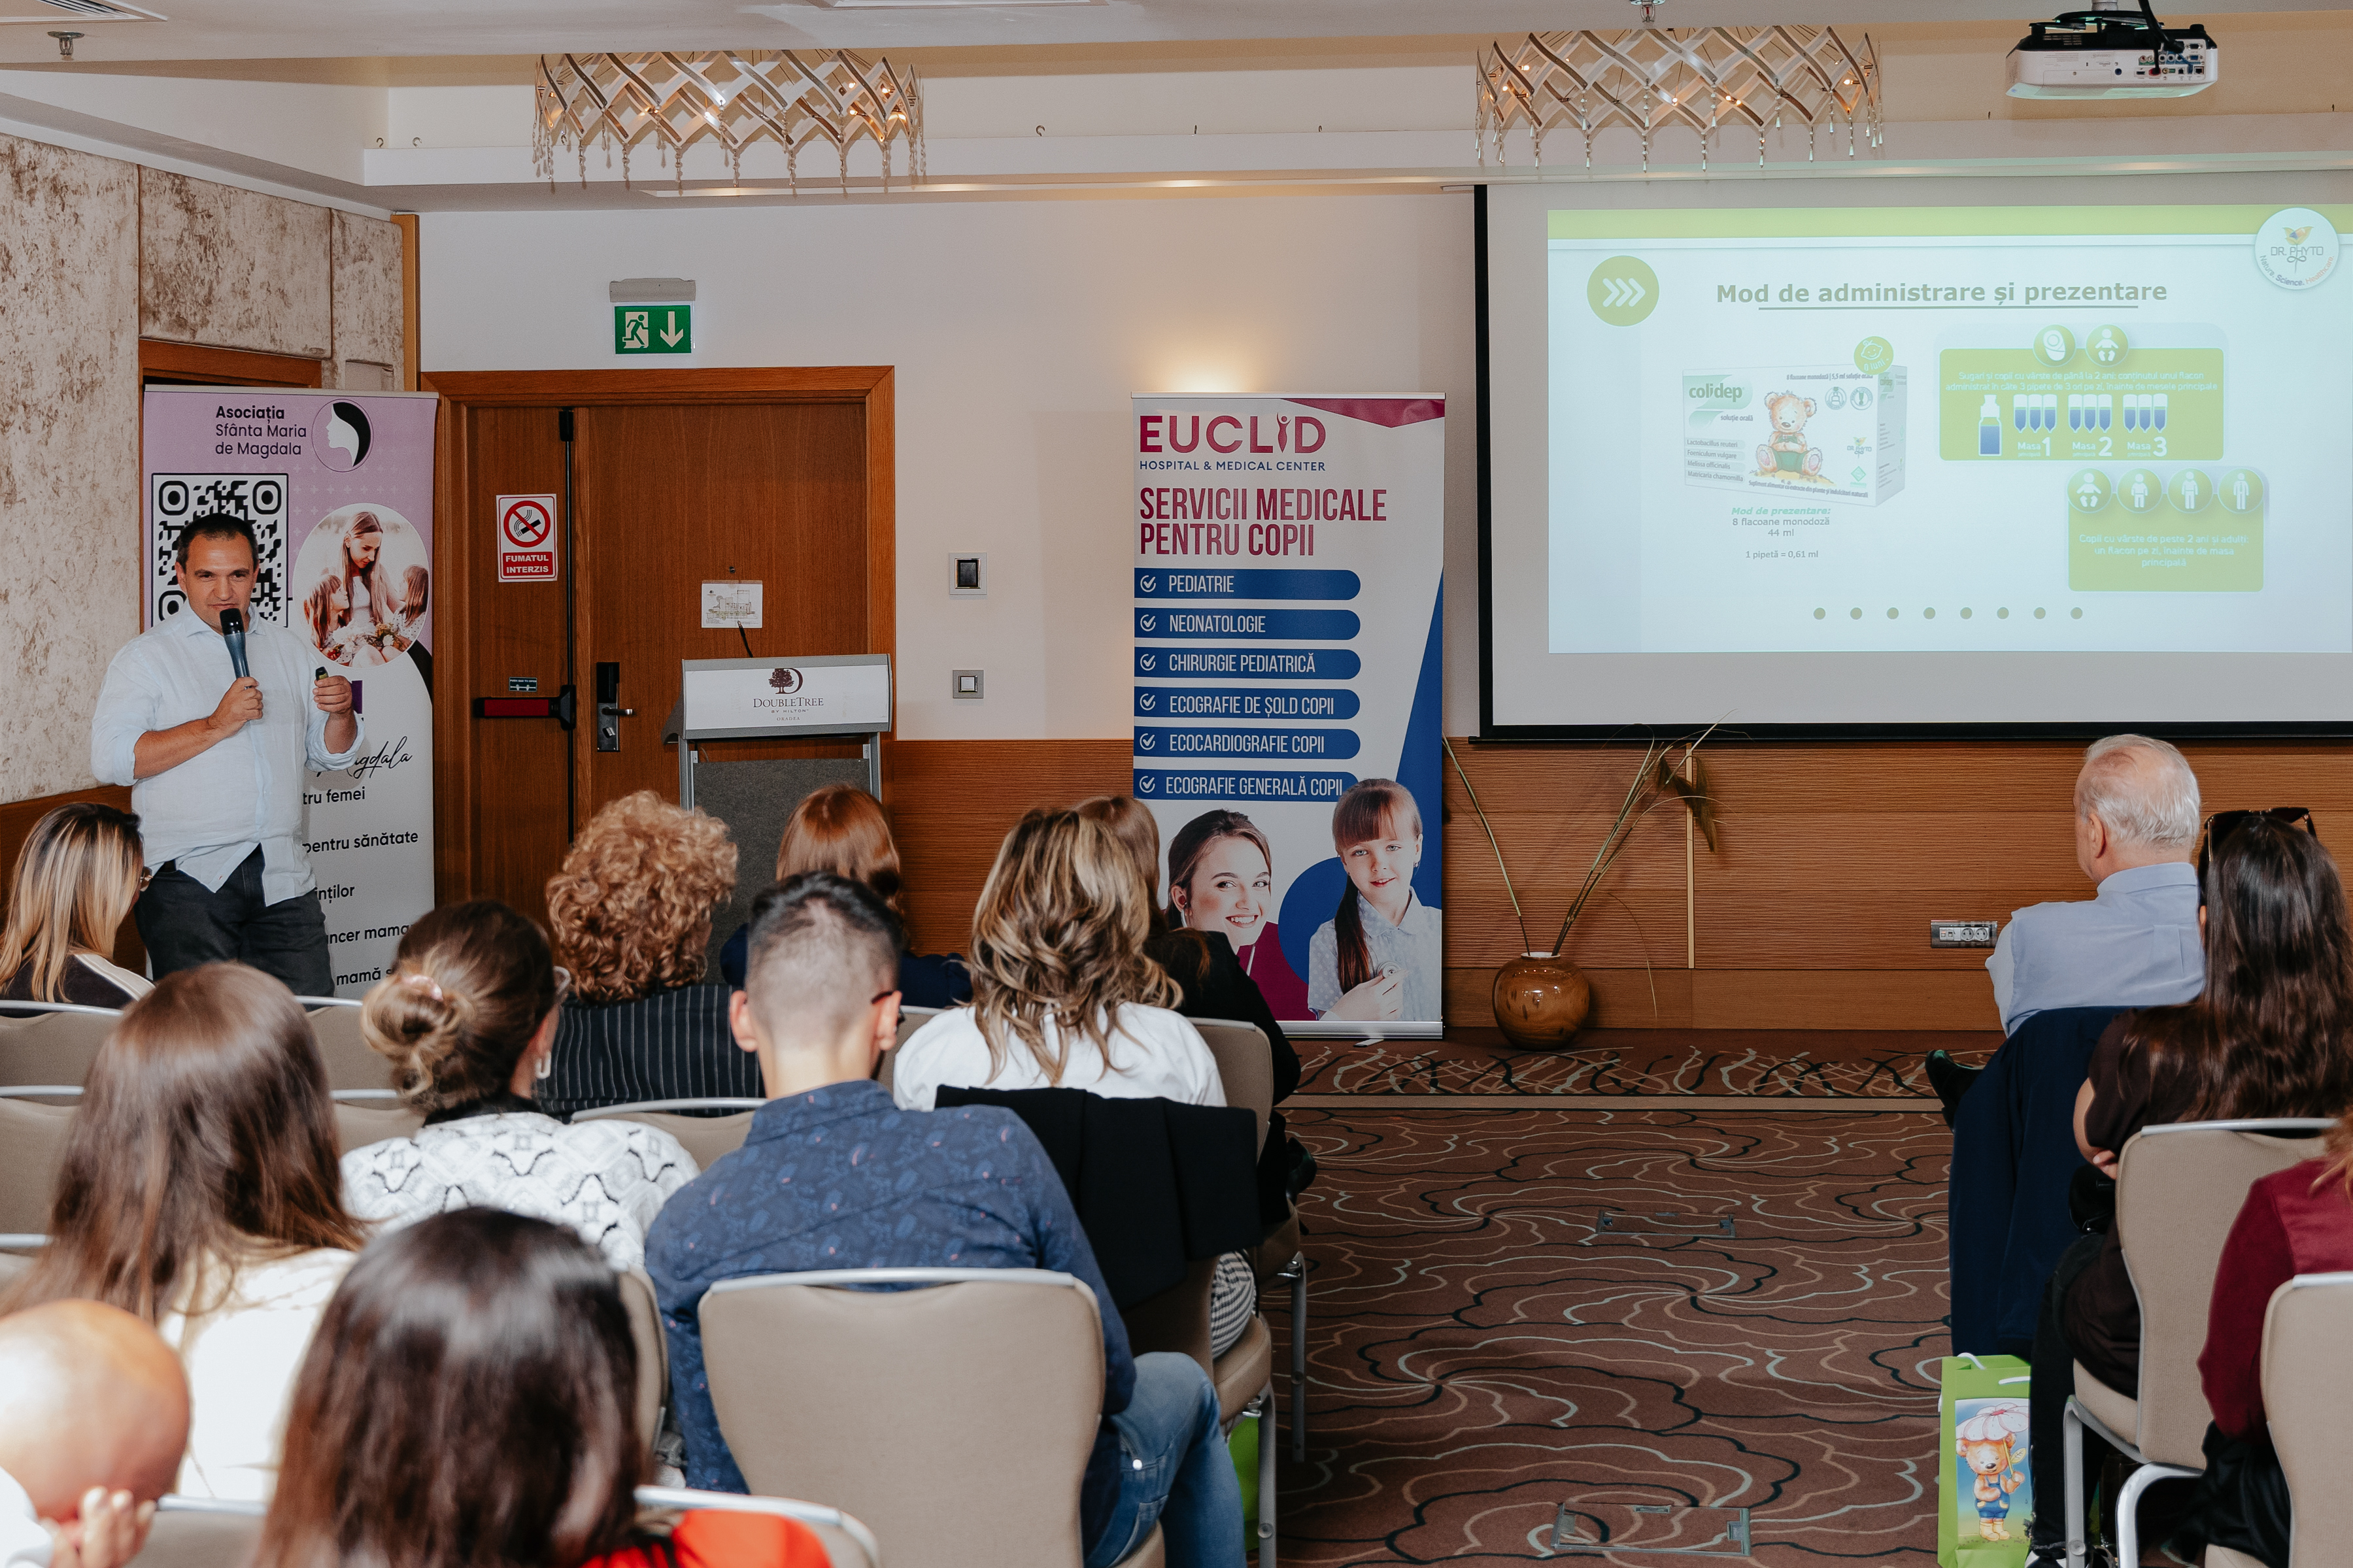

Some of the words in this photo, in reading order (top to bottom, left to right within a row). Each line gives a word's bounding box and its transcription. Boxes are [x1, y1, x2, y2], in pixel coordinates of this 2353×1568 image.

[2271, 246, 2287, 256] DR.
[2290, 246, 2324, 256] PHYTO
[1717, 284, 1769, 303] Mod
[1778, 284, 1809, 303] de
[1818, 282, 1986, 303] administrare
[1994, 282, 2015, 306] și
[2025, 282, 2167, 305] prezentare
[2052, 371, 2062, 380] de
[2085, 371, 2093, 380] la
[2094, 371, 2100, 380] 2
[2159, 371, 2177, 380] unui
[2179, 371, 2204, 380] flacon
[1689, 383, 1742, 402] colidep
[1946, 382, 1990, 391] administrat
[2027, 382, 2052, 392] pipete
[2054, 382, 2063, 391] de
[2178, 382, 2218, 392] principale
[216, 405, 285, 424] Asociația
[216, 423, 262, 437] Sfânta
[267, 424, 307, 437] Maria
[1140, 412, 1327, 454] EUCLID
[215, 442, 233, 454] de
[237, 442, 301, 459] Magdala
[2018, 442, 2041, 450] Masa
[2042, 437, 2051, 456] 1
[2072, 442, 2096, 450] Masa
[2098, 437, 2113, 456] 2
[2127, 442, 2151, 450] Masa
[2153, 436, 2168, 457] 3
[1140, 460, 1200, 471] HOSPITAL
[1204, 461, 1212, 471] &
[1216, 461, 1272, 471] MEDICAL
[1276, 461, 1326, 472] CENTER
[1713, 473, 1744, 482] chamomilla
[1140, 487, 1247, 520] SERVICII
[1257, 488, 1387, 521] MEDICALE
[1731, 507, 1753, 515] Mod
[1755, 507, 1768, 515] de
[1770, 507, 1831, 516] prezentare:
[1783, 517, 1830, 525] monodoză
[1140, 523, 1240, 555] PENTRU
[1248, 524, 1314, 556] COPII
[2079, 534, 2102, 544] Copii
[2116, 534, 2145, 543] vârste
[2146, 535, 2158, 543] de
[2159, 535, 2185, 544] peste
[2187, 535, 2193, 543] 2
[2195, 535, 2209, 543] ani
[1753, 550, 1779, 559] pipetă
[1788, 550, 1806, 559] 0,61
[2108, 546, 2135, 555] flacon
[2196, 546, 2208, 555] de
[506, 565, 549, 574] INTERZIS
[2141, 558, 2187, 568] principală
[1168, 575, 1234, 593] PEDIATRIE
[1170, 614, 1266, 633] NEONATOLOGIE
[1169, 654, 1237, 672] CHIRURGIE
[1240, 652, 1316, 673] PEDIATRICĂ
[1170, 695, 1241, 714] ECOGRAFIE
[1245, 696, 1261, 714] DE
[1265, 696, 1298, 718] ȘOLD
[1301, 697, 1334, 714] COPII
[1170, 734, 1288, 752] ECOCARDIOGRAFIE
[1292, 735, 1325, 753] COPII
[347, 736, 413, 778] gdala
[326, 786, 365, 803] femei
[1166, 776, 1236, 795] ECOGRAFIE
[1240, 775, 1307, 795] GENERALĂ
[1310, 778, 1343, 796] COPII
[354, 831, 418, 848] sănătate
[327, 930, 360, 944] ncer
[364, 924, 412, 939] mama
[337, 967, 381, 986] mamă
